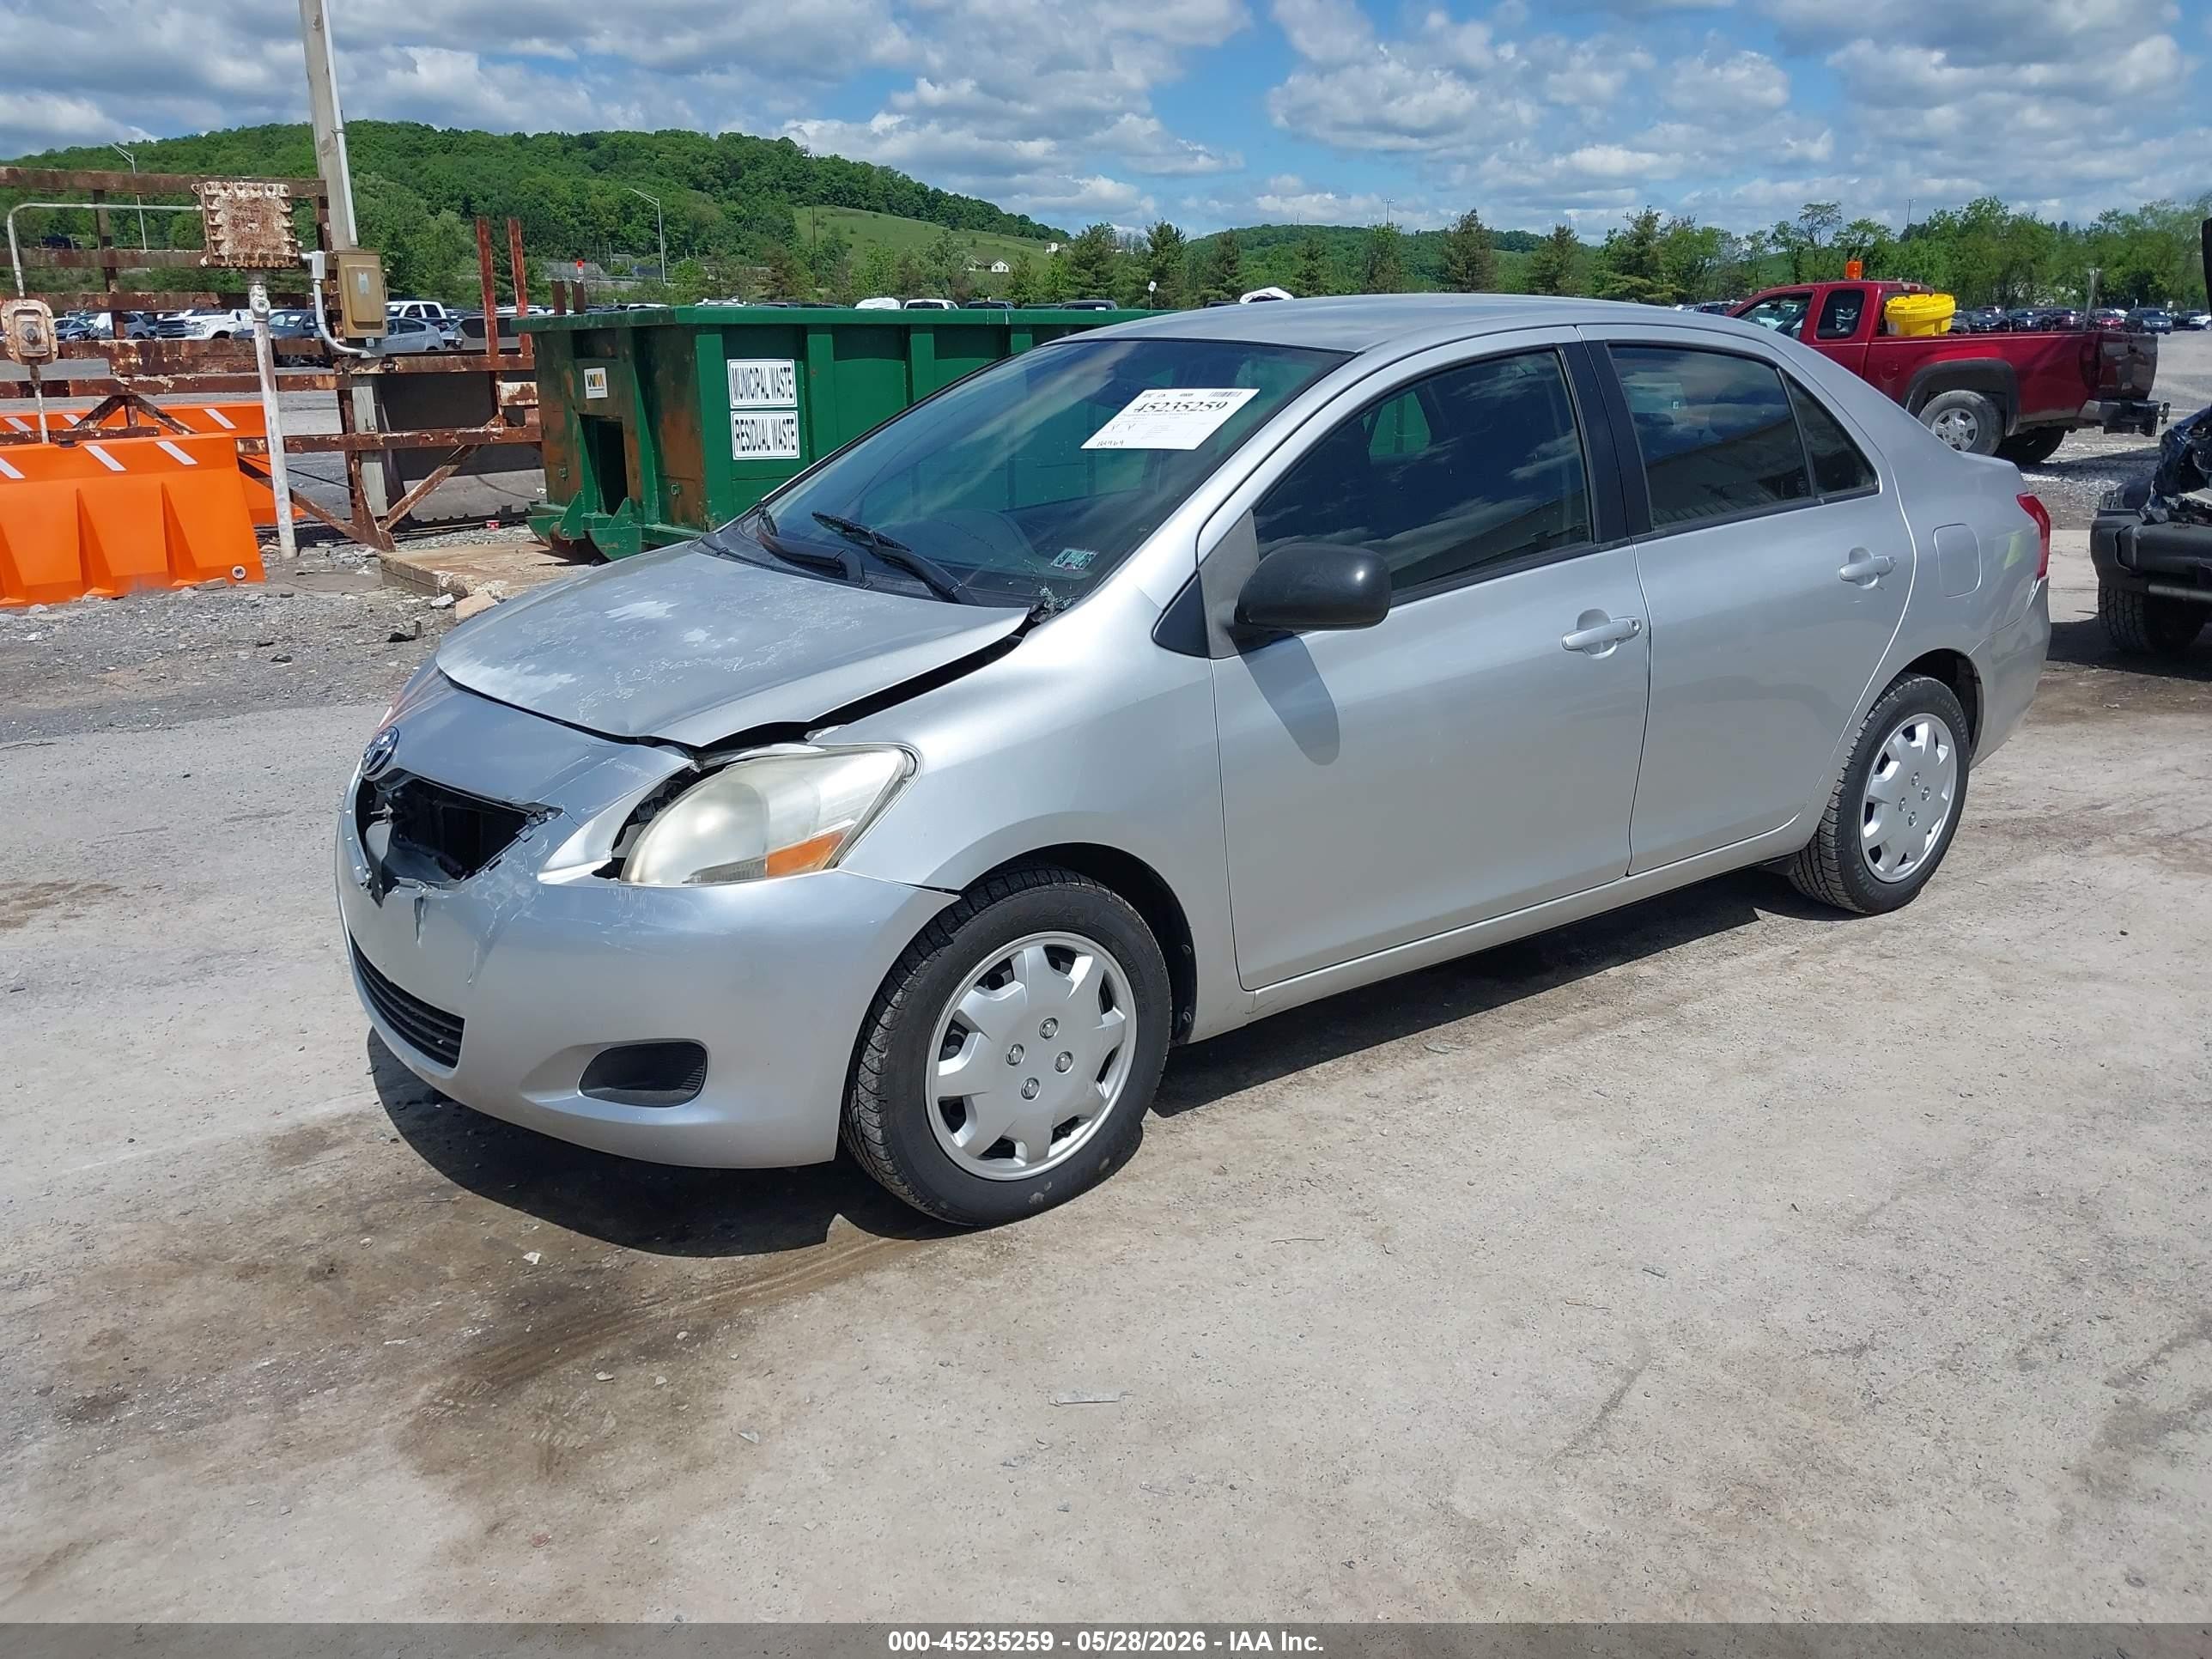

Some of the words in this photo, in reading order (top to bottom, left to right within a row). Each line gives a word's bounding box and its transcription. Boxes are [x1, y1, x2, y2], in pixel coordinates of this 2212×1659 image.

[586, 374, 605, 387] WM
[732, 367, 769, 401] MUNICIPAL
[769, 367, 793, 399] WASTE
[1133, 400, 1228, 413] 45235259
[734, 418, 771, 452] RESIDUAL
[771, 418, 796, 451] WASTE
